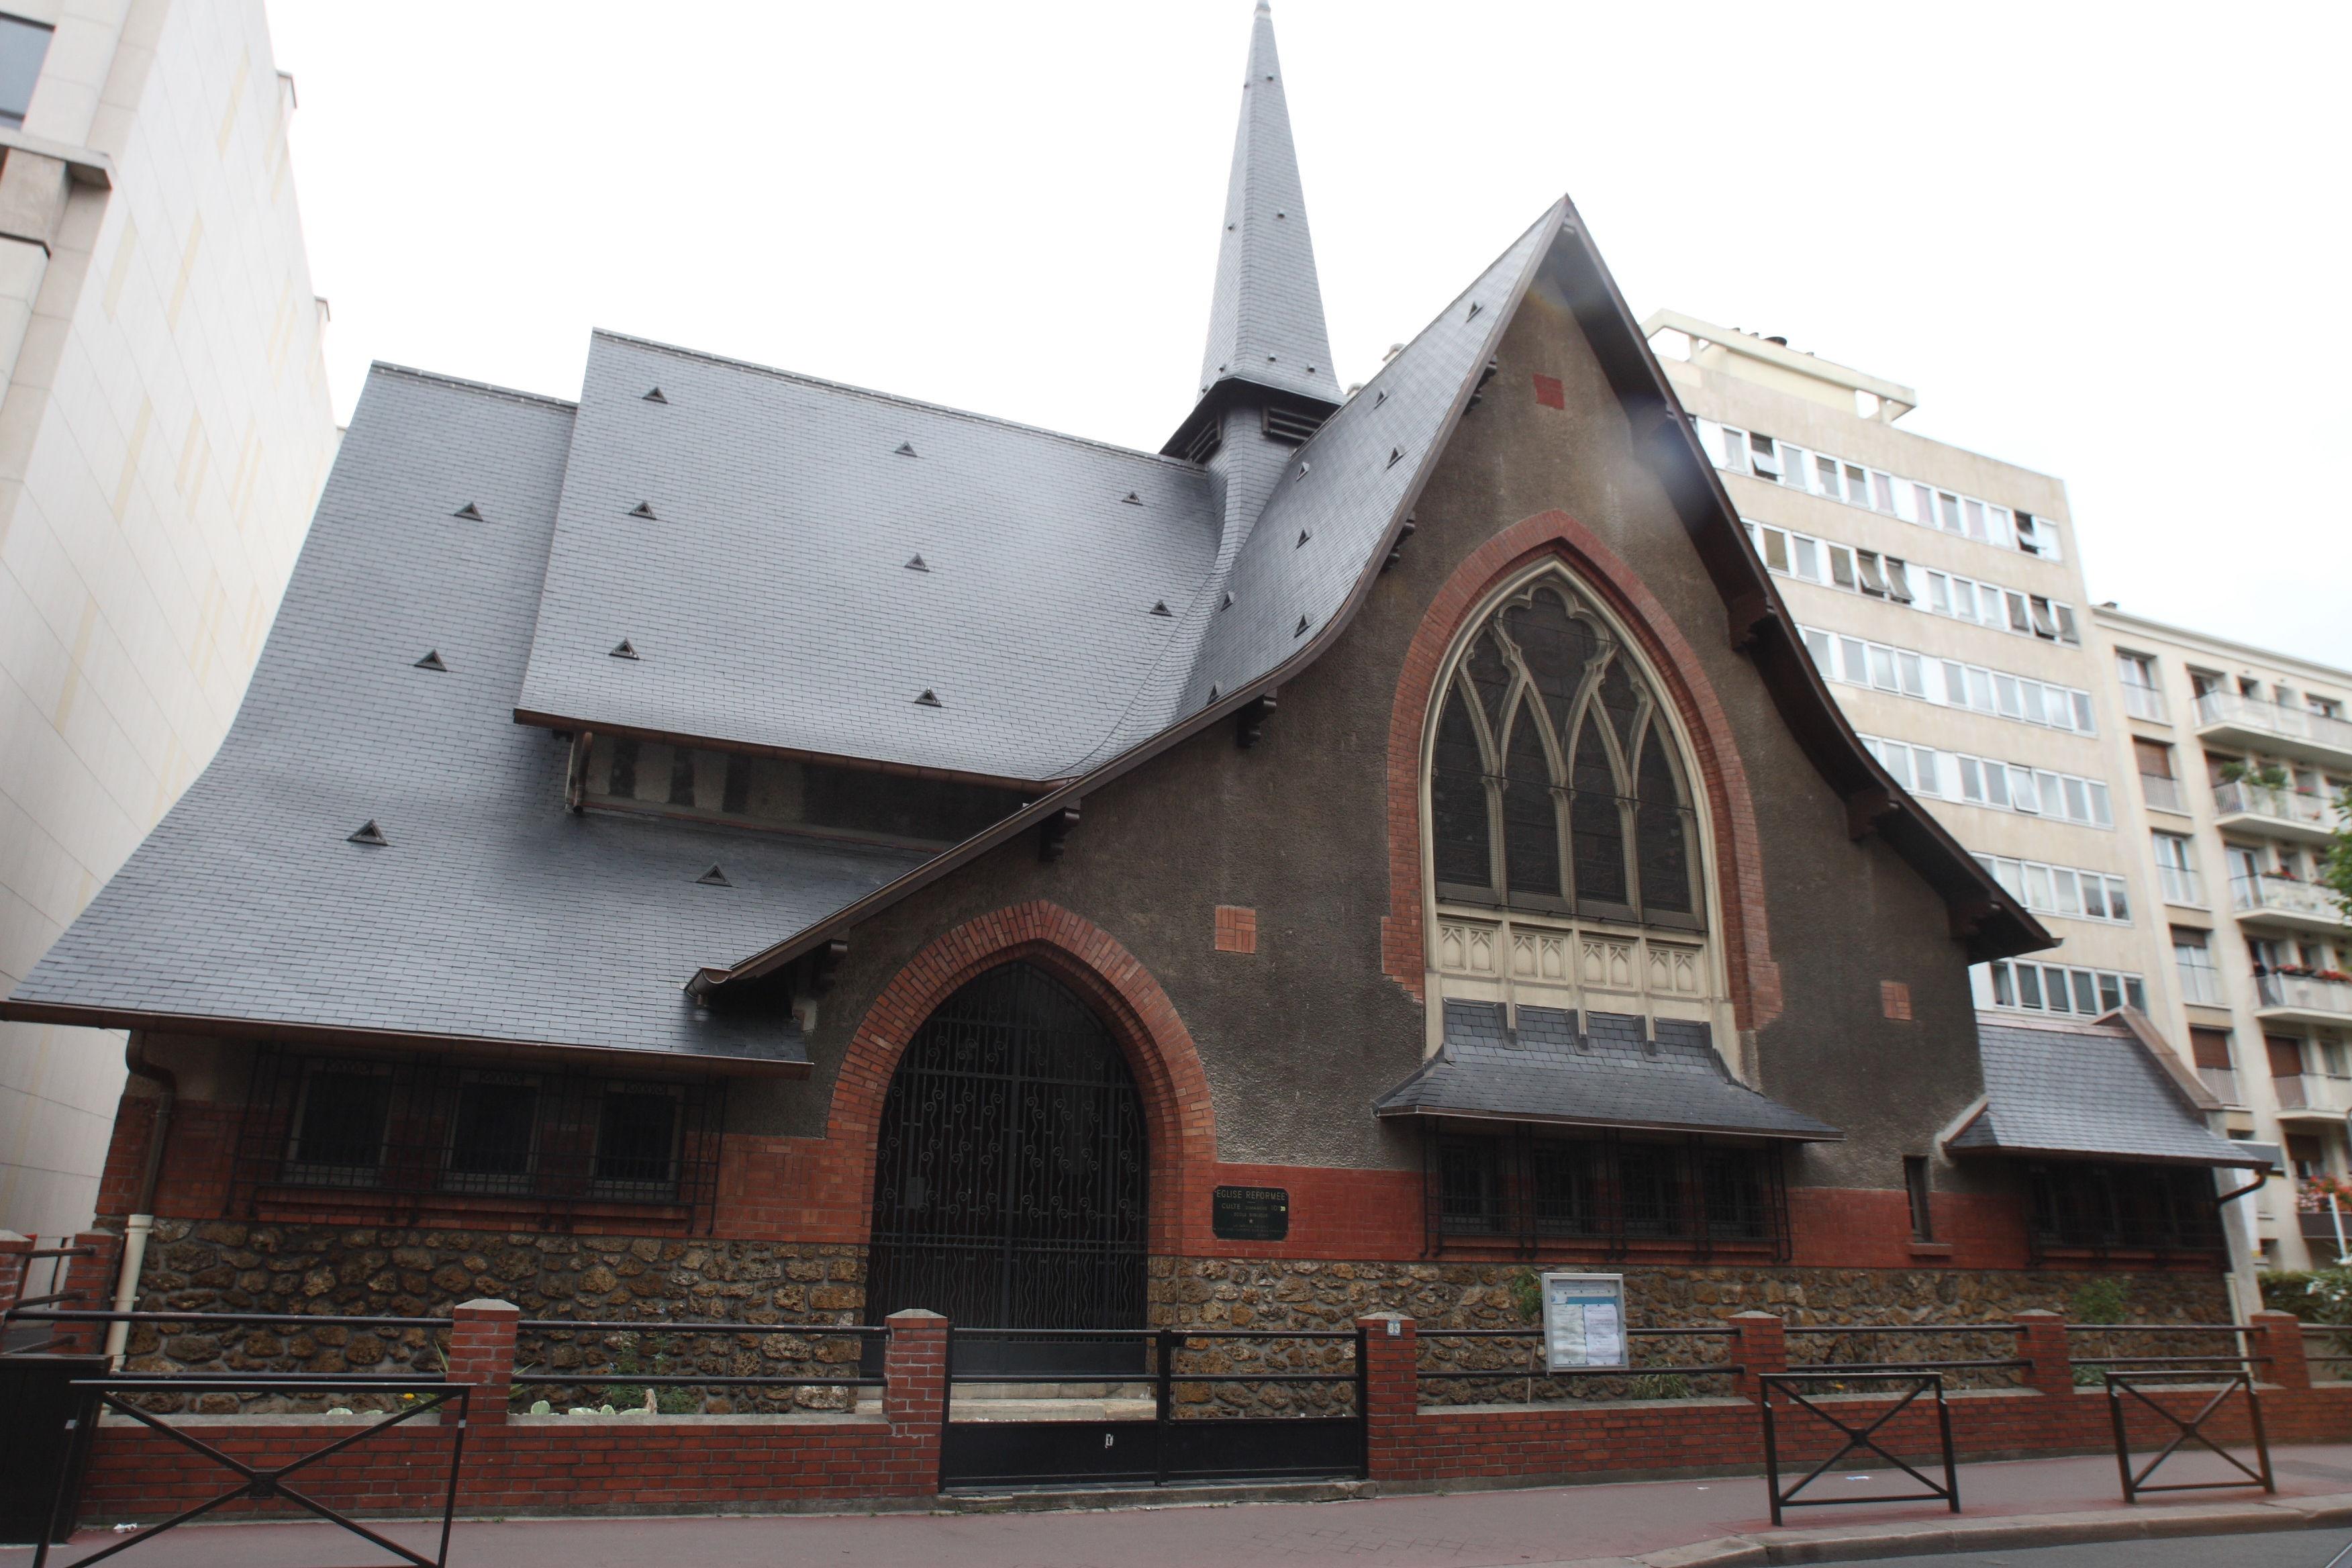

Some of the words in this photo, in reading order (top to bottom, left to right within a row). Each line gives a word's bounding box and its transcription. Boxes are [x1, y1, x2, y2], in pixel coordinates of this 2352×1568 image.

[1216, 1189, 1242, 1198] EGLISE
[1246, 1191, 1285, 1200] REFORMEE
[1388, 1323, 1401, 1333] 83
